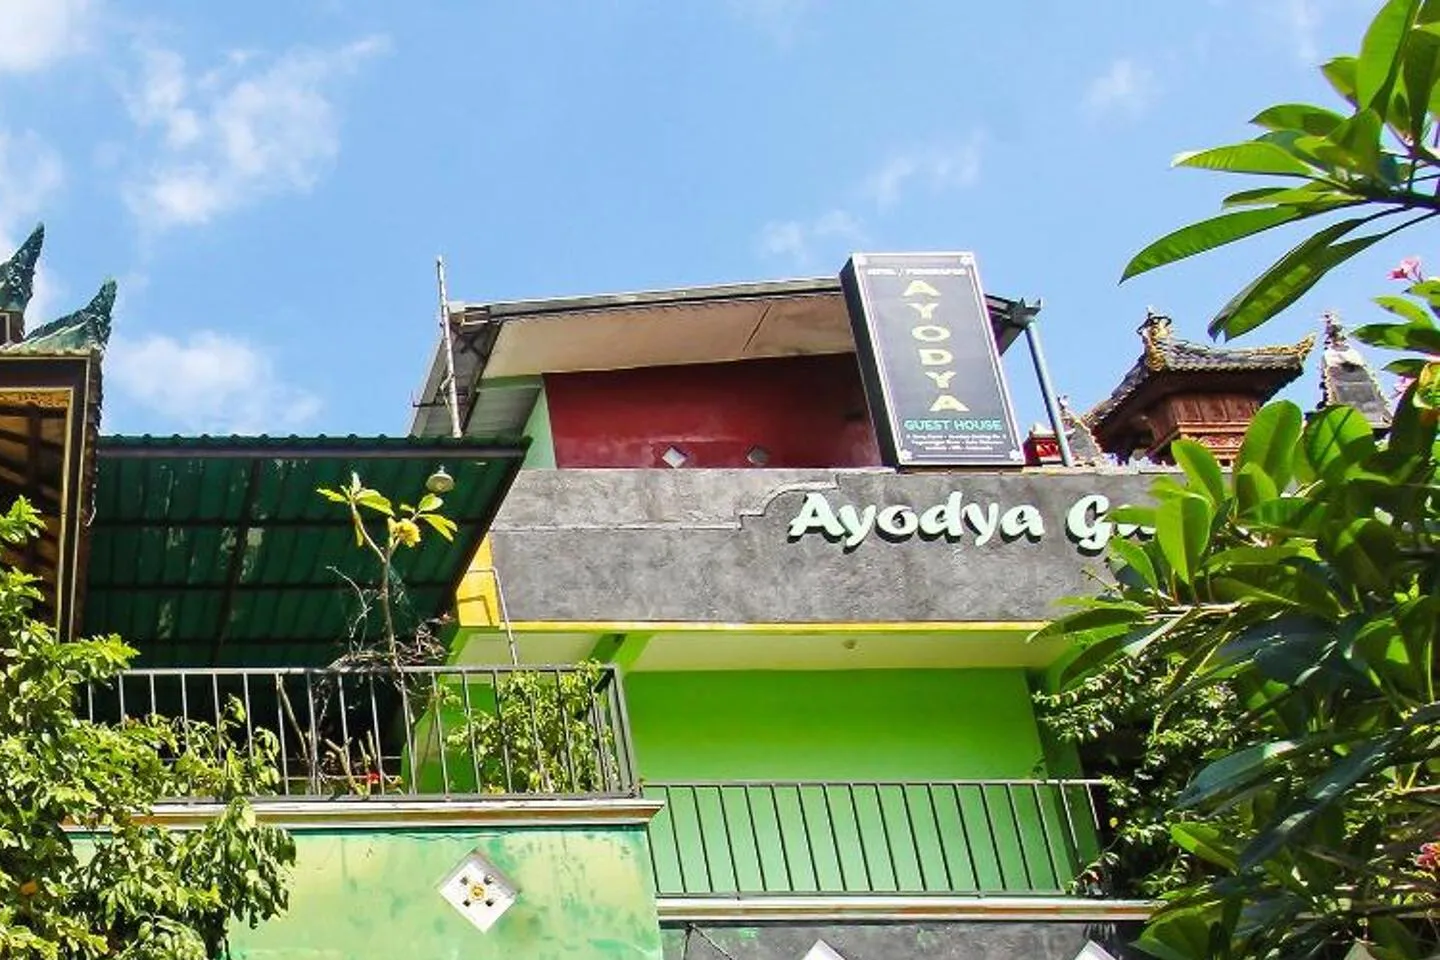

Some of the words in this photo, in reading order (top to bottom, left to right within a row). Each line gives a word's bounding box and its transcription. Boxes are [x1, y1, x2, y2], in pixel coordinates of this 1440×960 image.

[902, 280, 970, 412] AYODYA
[903, 419, 951, 431] GUEST
[953, 419, 1003, 431] HOUSE
[788, 491, 1045, 550] Ayodya
